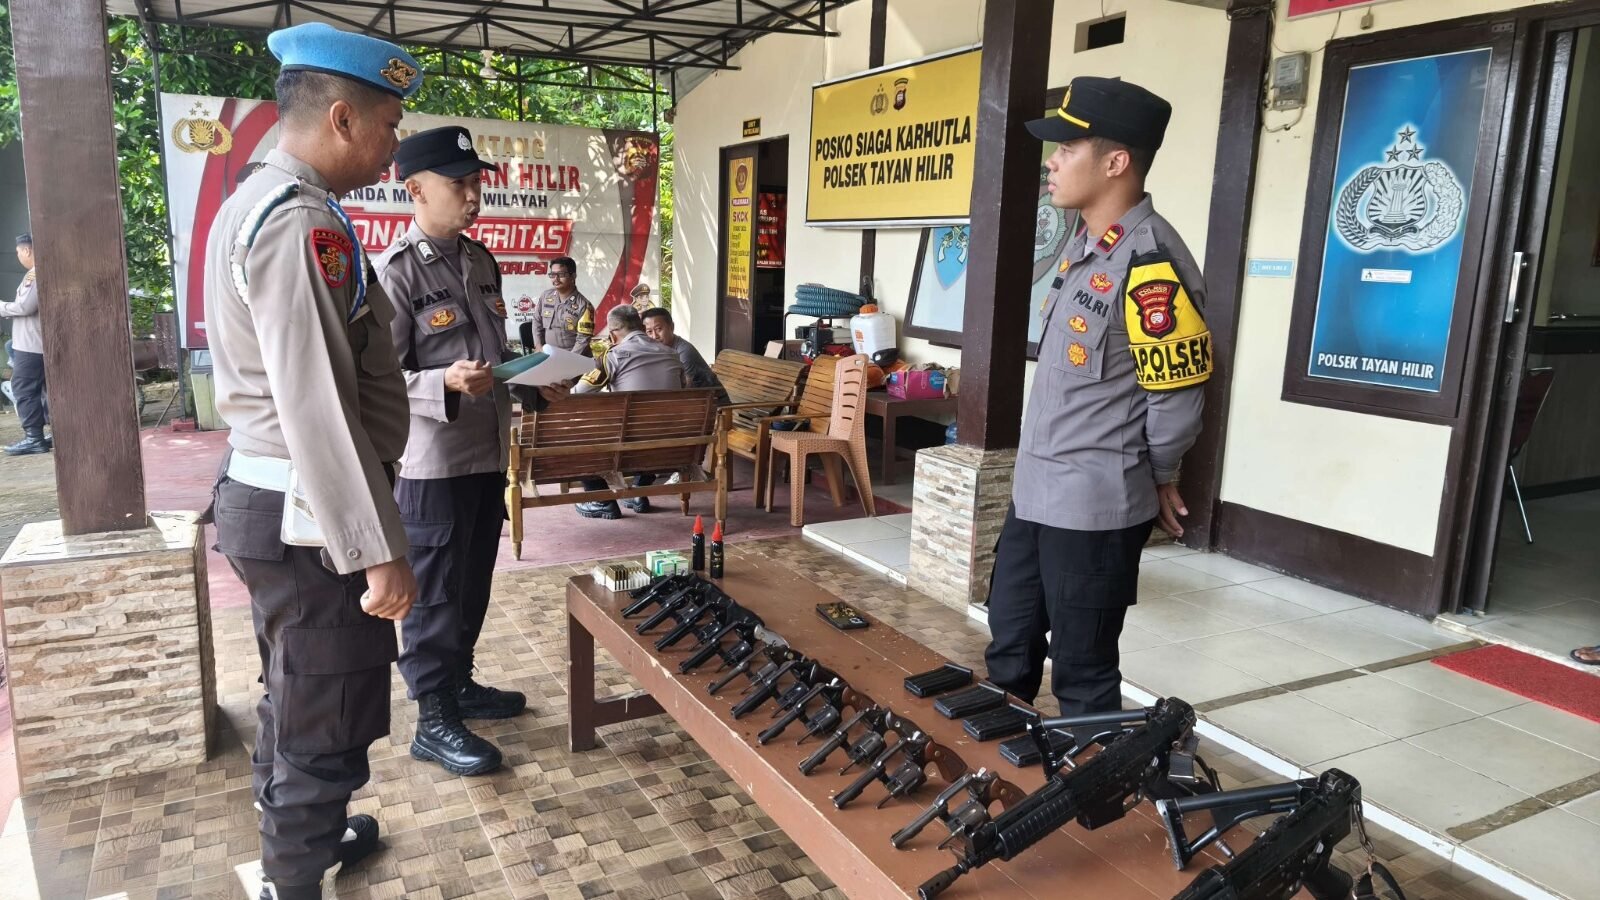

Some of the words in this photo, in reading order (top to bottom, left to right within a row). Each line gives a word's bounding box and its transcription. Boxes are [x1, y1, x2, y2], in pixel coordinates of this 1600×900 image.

[476, 135, 545, 159] ATANG
[815, 134, 853, 161] POSKO
[856, 128, 892, 157] SIAGA
[895, 116, 971, 152] KARHUTLA
[518, 163, 581, 192] HILIR
[823, 162, 868, 189] POLSEK
[870, 157, 913, 185] TAYAN
[915, 153, 954, 181] HILIR
[483, 193, 548, 208] WILAYAH
[733, 211, 748, 222] SKCK
[350, 219, 407, 246] ONA
[499, 261, 548, 275] ORUPSI
[480, 284, 499, 295] POL
[1073, 290, 1109, 318] POLRI
[1138, 371, 1166, 383] YAN
[1169, 363, 1208, 380] HILIR
[1317, 353, 1359, 370] POLSEK
[1361, 357, 1399, 375] TAYAN
[1401, 361, 1435, 379] HILIR
